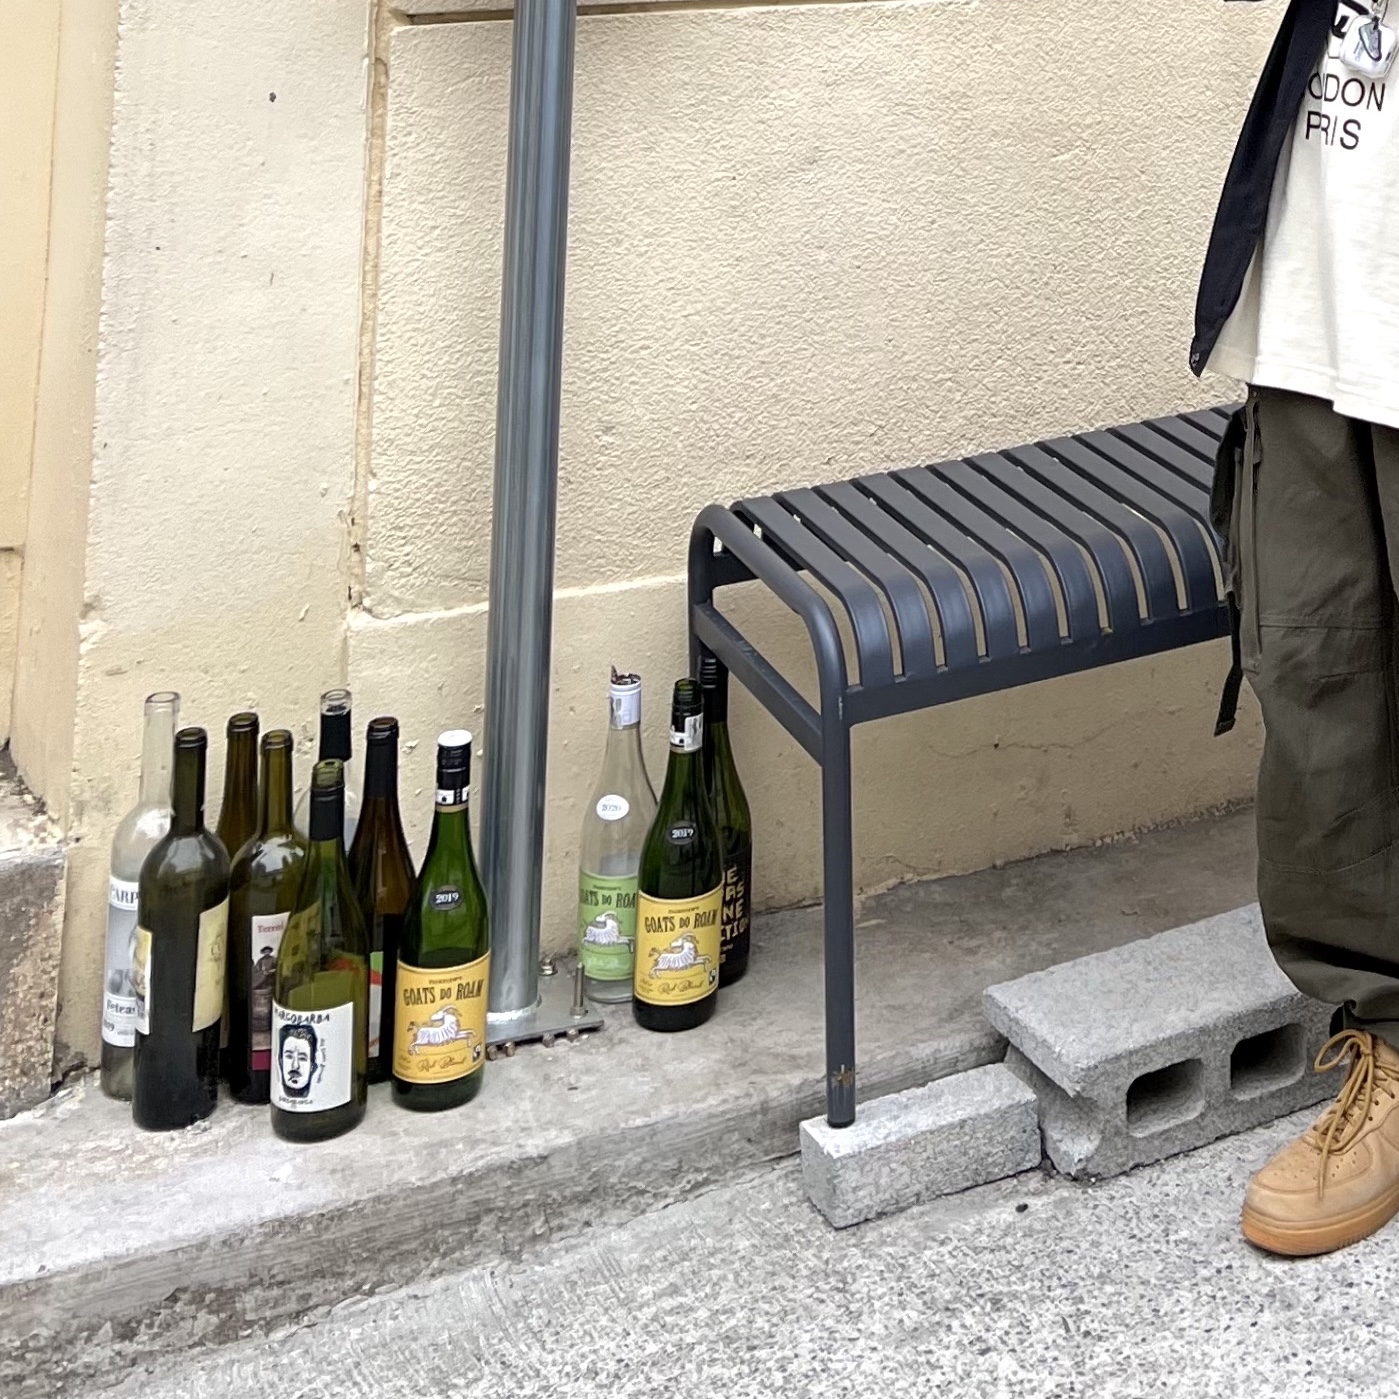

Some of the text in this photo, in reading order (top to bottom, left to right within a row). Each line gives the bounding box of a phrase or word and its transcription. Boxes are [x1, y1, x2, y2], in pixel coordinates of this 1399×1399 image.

[616, 892, 636, 909] ROA
[644, 915, 676, 933] GOATS
[679, 916, 690, 929] DO
[402, 986, 436, 1006] GOATS
[440, 987, 452, 1001] DO
